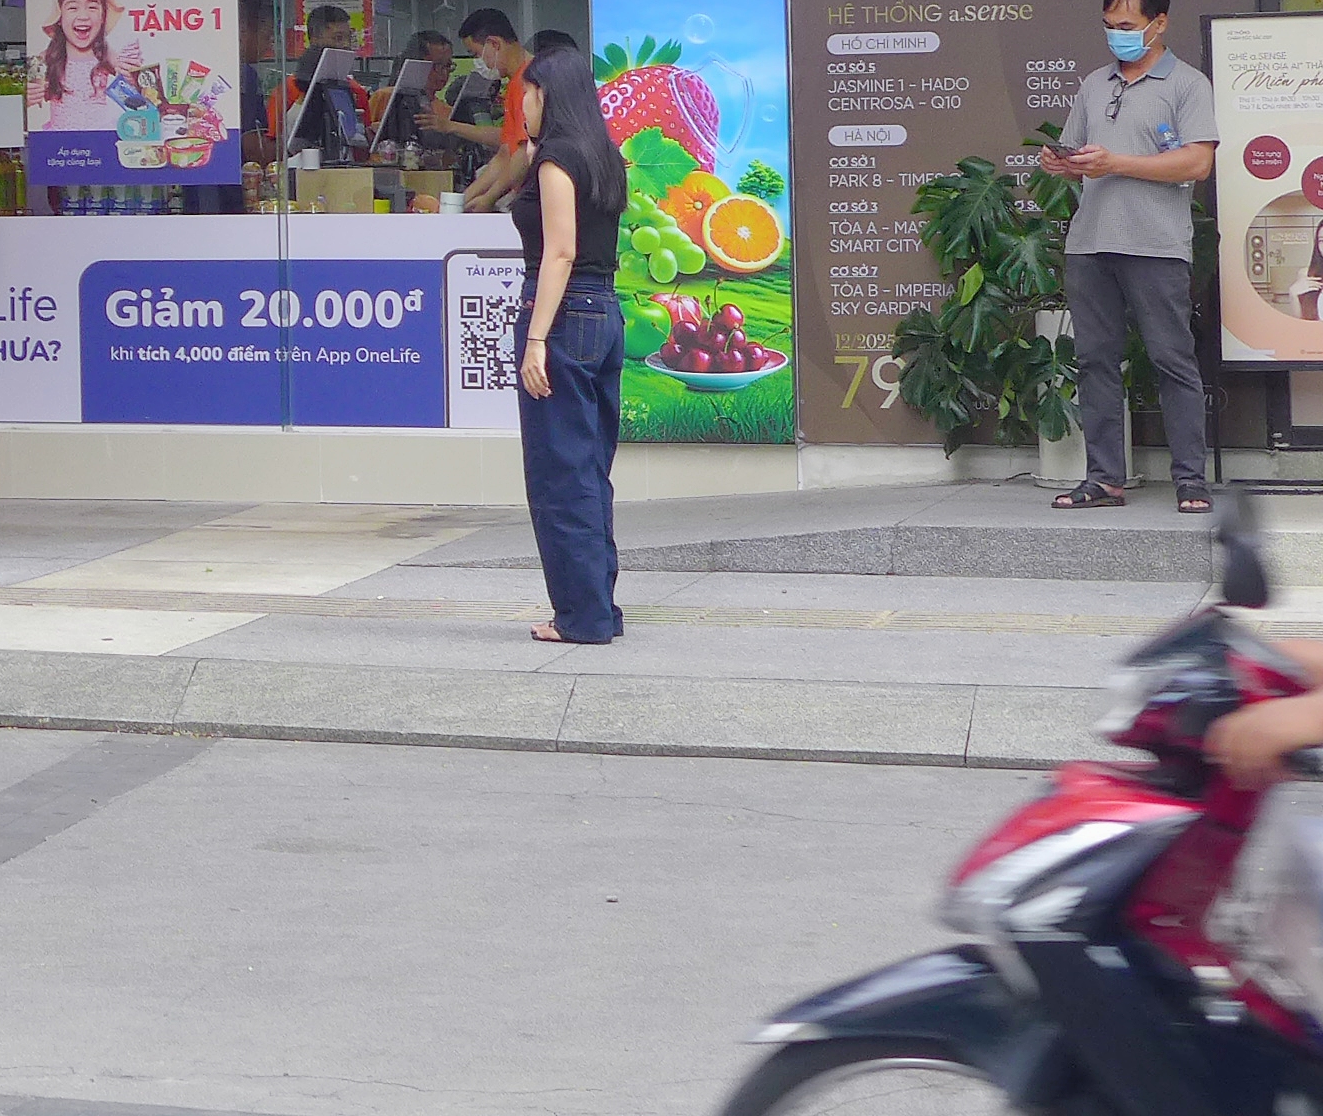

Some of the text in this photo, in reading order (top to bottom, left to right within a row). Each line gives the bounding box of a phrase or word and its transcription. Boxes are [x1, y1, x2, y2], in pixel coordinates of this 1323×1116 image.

[128, 3, 222, 38] TẶNG 1
[827, 0, 1034, 28] HỆ THỐNG a.sense
[865, 37, 890, 51] CHÍ
[893, 37, 927, 50] MINH
[868, 63, 876, 72] 5
[1068, 60, 1076, 71] 9
[827, 77, 970, 94] JASMINE 1 HADO
[1026, 76, 1062, 90] GH6
[827, 95, 961, 111] CENTROSA Q10
[1026, 94, 1078, 108] GRAN
[843, 127, 891, 144] HÀ NỘI
[869, 156, 876, 167] 1
[829, 173, 868, 188] PARK
[871, 172, 882, 187] 8
[872, 202, 879, 212] 3
[829, 218, 864, 235] TÒA
[865, 220, 879, 234] A
[829, 238, 923, 253] SMART CITY
[465, 264, 513, 278] TẢI APP
[872, 266, 879, 276] 7
[830, 282, 865, 297] TÒA
[868, 284, 878, 297] B
[104, 286, 225, 329] Giảm
[830, 301, 860, 315] SKY
[110, 346, 134, 362] khi
[136, 345, 171, 362] tích
[174, 347, 223, 365] 4,000
[227, 344, 271, 363] điểm
[316, 347, 352, 366] App
[354, 348, 422, 365] OneLife
